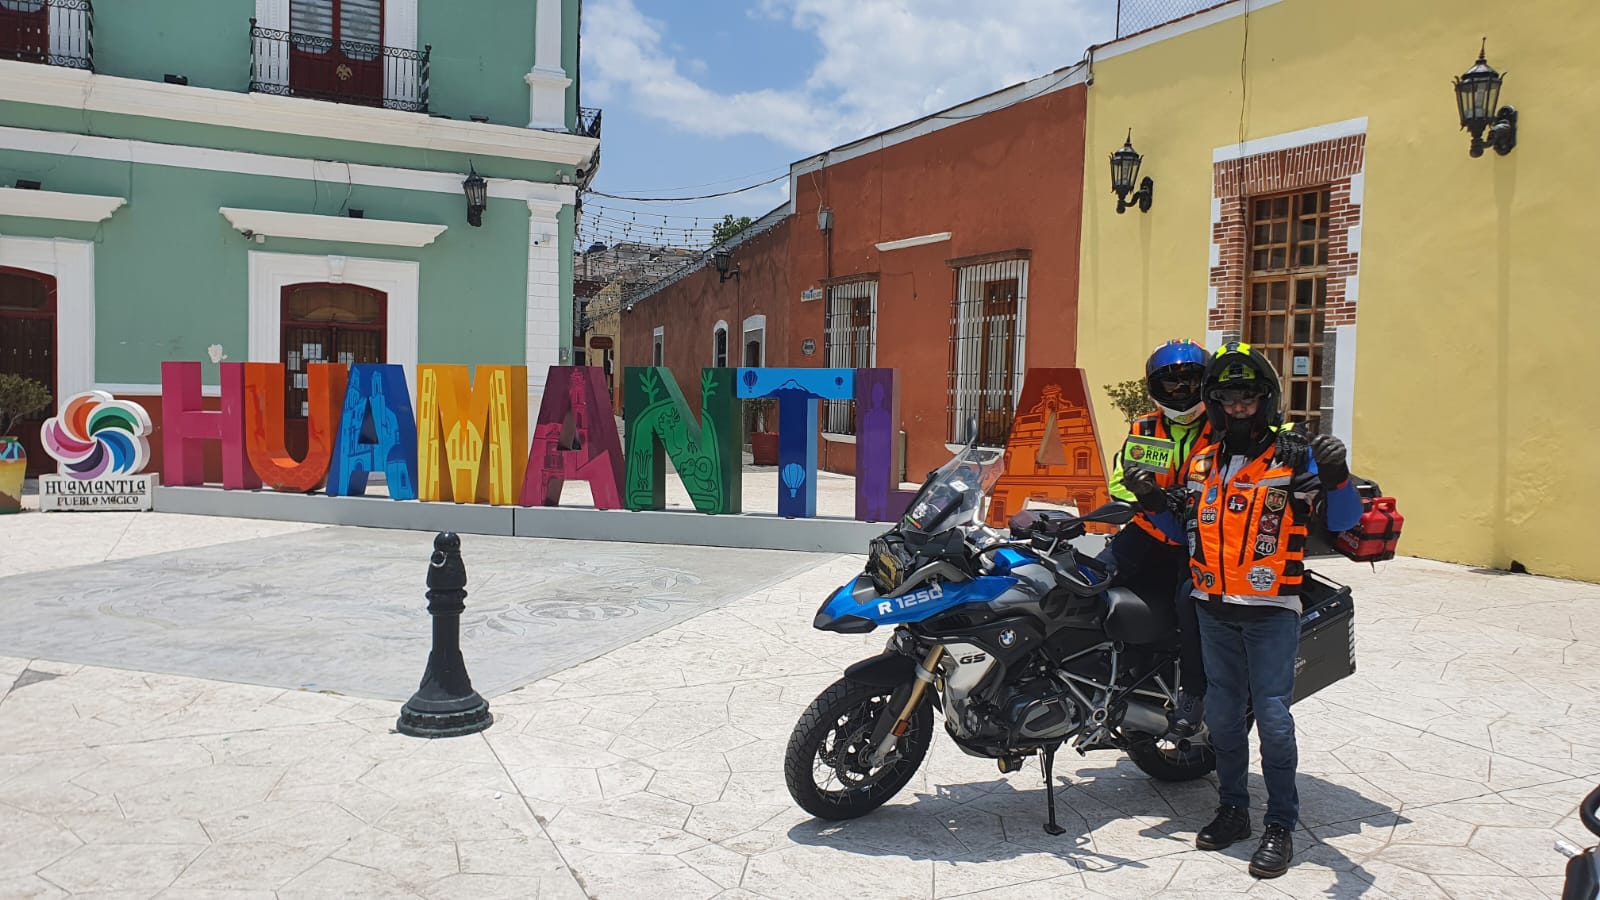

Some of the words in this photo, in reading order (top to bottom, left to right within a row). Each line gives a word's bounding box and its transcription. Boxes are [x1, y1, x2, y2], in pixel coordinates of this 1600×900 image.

[1145, 449, 1169, 463] RRM
[1258, 541, 1273, 553] 40
[878, 601, 893, 615] R
[895, 588, 944, 609] 1250
[960, 652, 986, 665] GS
